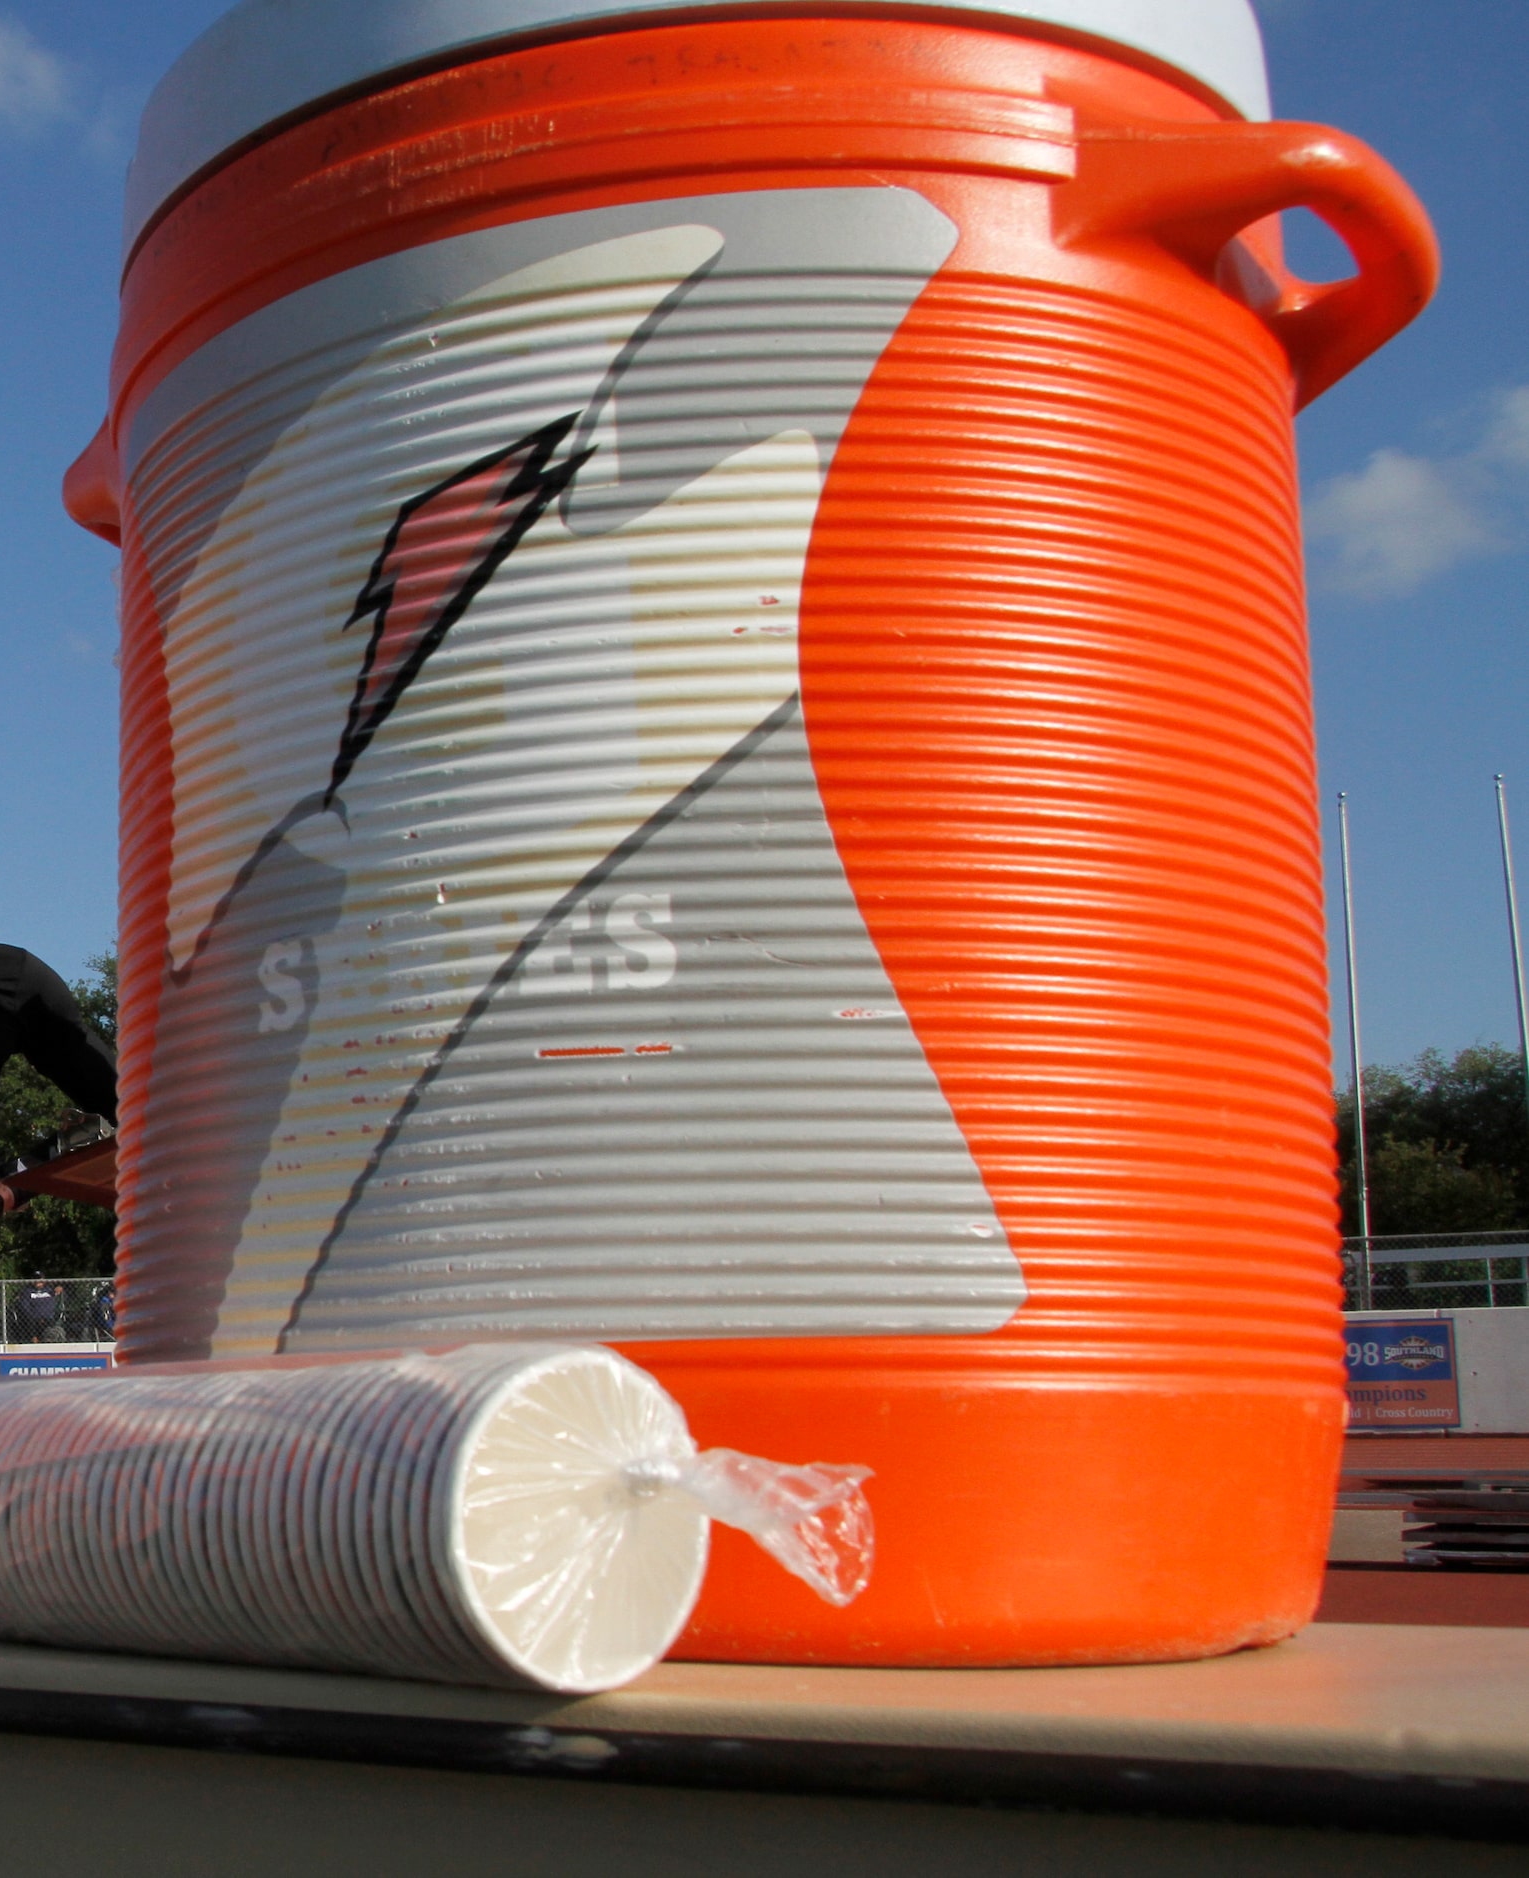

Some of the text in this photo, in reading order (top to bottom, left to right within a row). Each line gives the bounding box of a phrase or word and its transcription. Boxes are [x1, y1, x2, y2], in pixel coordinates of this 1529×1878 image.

[1346, 1341, 1380, 1367] 98
[1384, 1345, 1445, 1361] SOUTHLAND
[1375, 1407, 1406, 1418] Cross
[1408, 1406, 1454, 1420] Country
